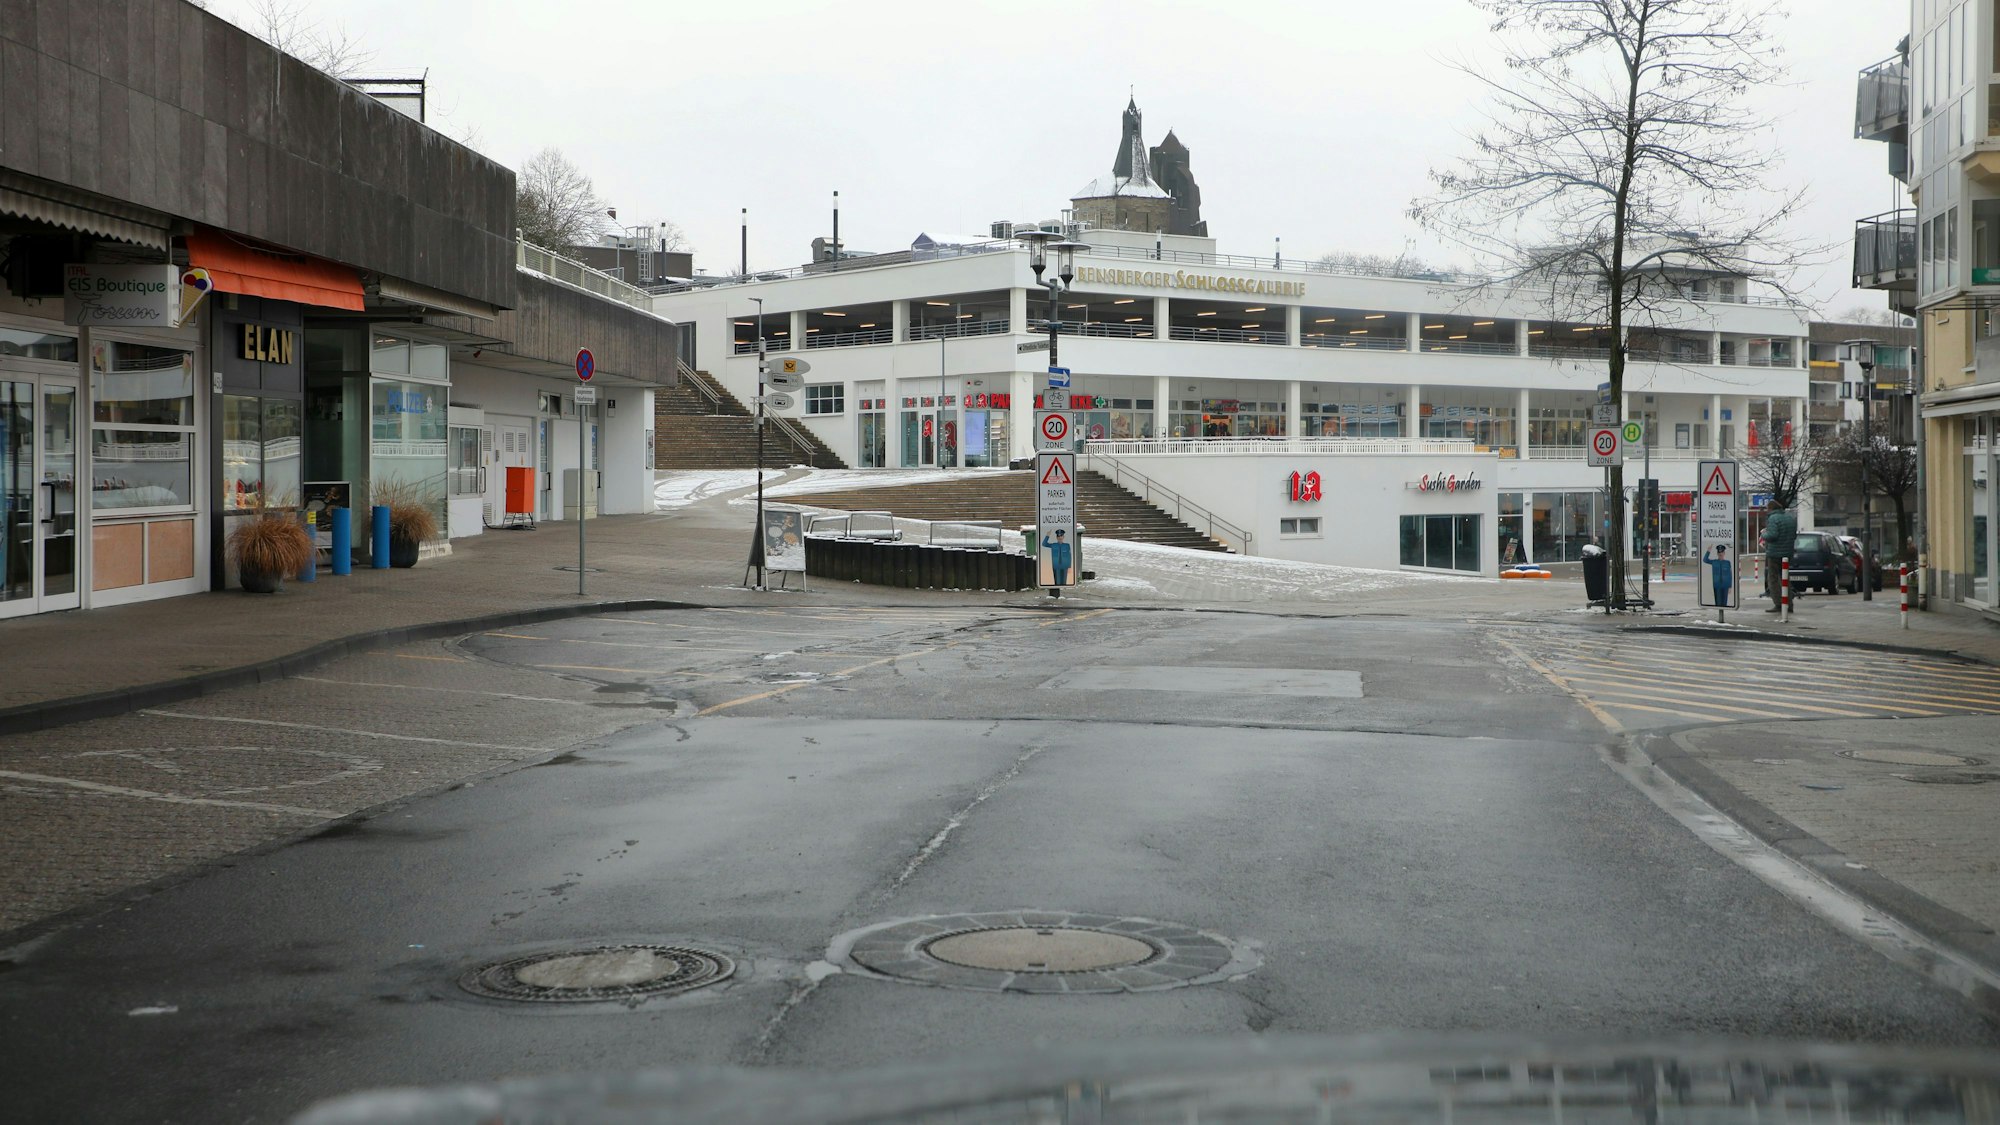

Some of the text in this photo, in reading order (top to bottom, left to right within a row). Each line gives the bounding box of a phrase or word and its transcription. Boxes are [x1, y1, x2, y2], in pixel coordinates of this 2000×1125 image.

[67, 266, 90, 276] ITAL
[1078, 267, 1170, 288] BENSBERGER
[68, 277, 166, 295] EIS Boutique
[244, 323, 293, 365] ELAN
[1048, 421, 1062, 433] 20
[1045, 441, 1065, 449] ZONE
[1599, 437, 1612, 449] 20
[1418, 471, 1481, 493] Sushi Garden
[1047, 489, 1066, 498] PARKEN
[1708, 501, 1727, 510] PARKEN
[1042, 514, 1072, 524] UNZULÄSSIG
[1703, 527, 1732, 539] UNZULÄSSIG
